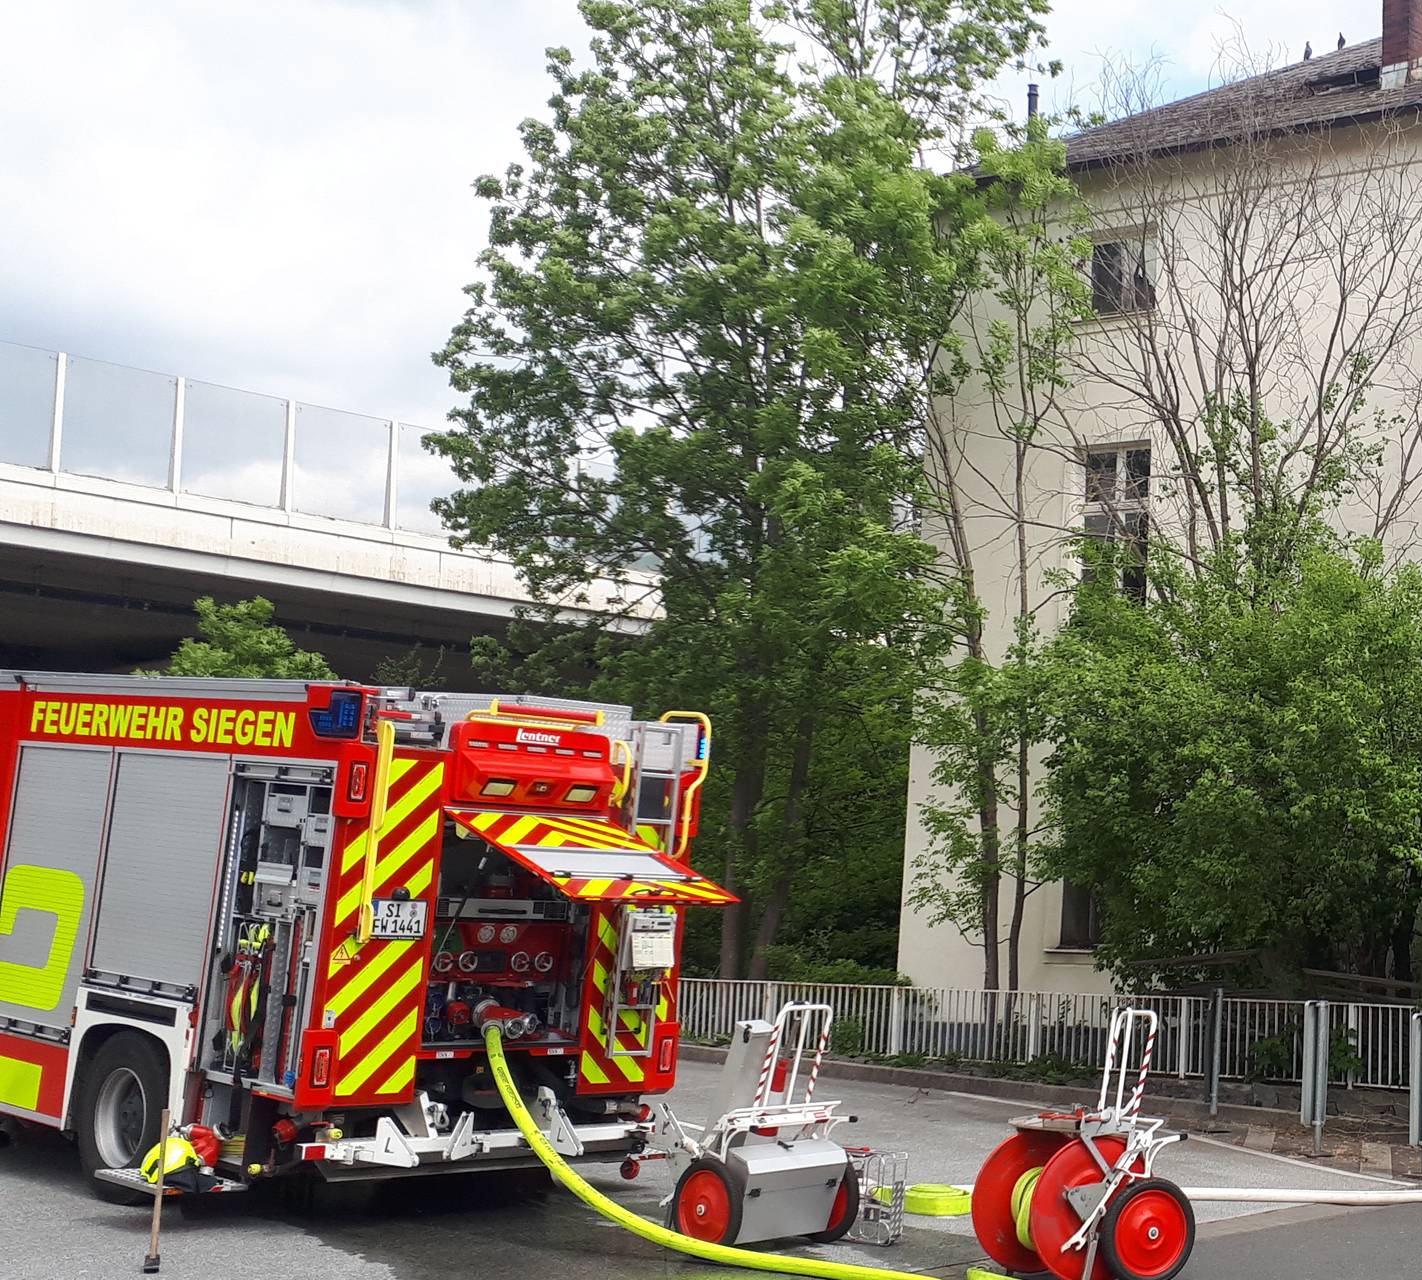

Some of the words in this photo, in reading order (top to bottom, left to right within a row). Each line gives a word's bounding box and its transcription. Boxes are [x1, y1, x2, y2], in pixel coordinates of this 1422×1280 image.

[31, 701, 184, 741] FEUERWEHR
[190, 707, 296, 748] SIEGEN
[386, 904, 401, 918] SI
[372, 918, 389, 933] FW
[391, 919, 421, 933] 1441
